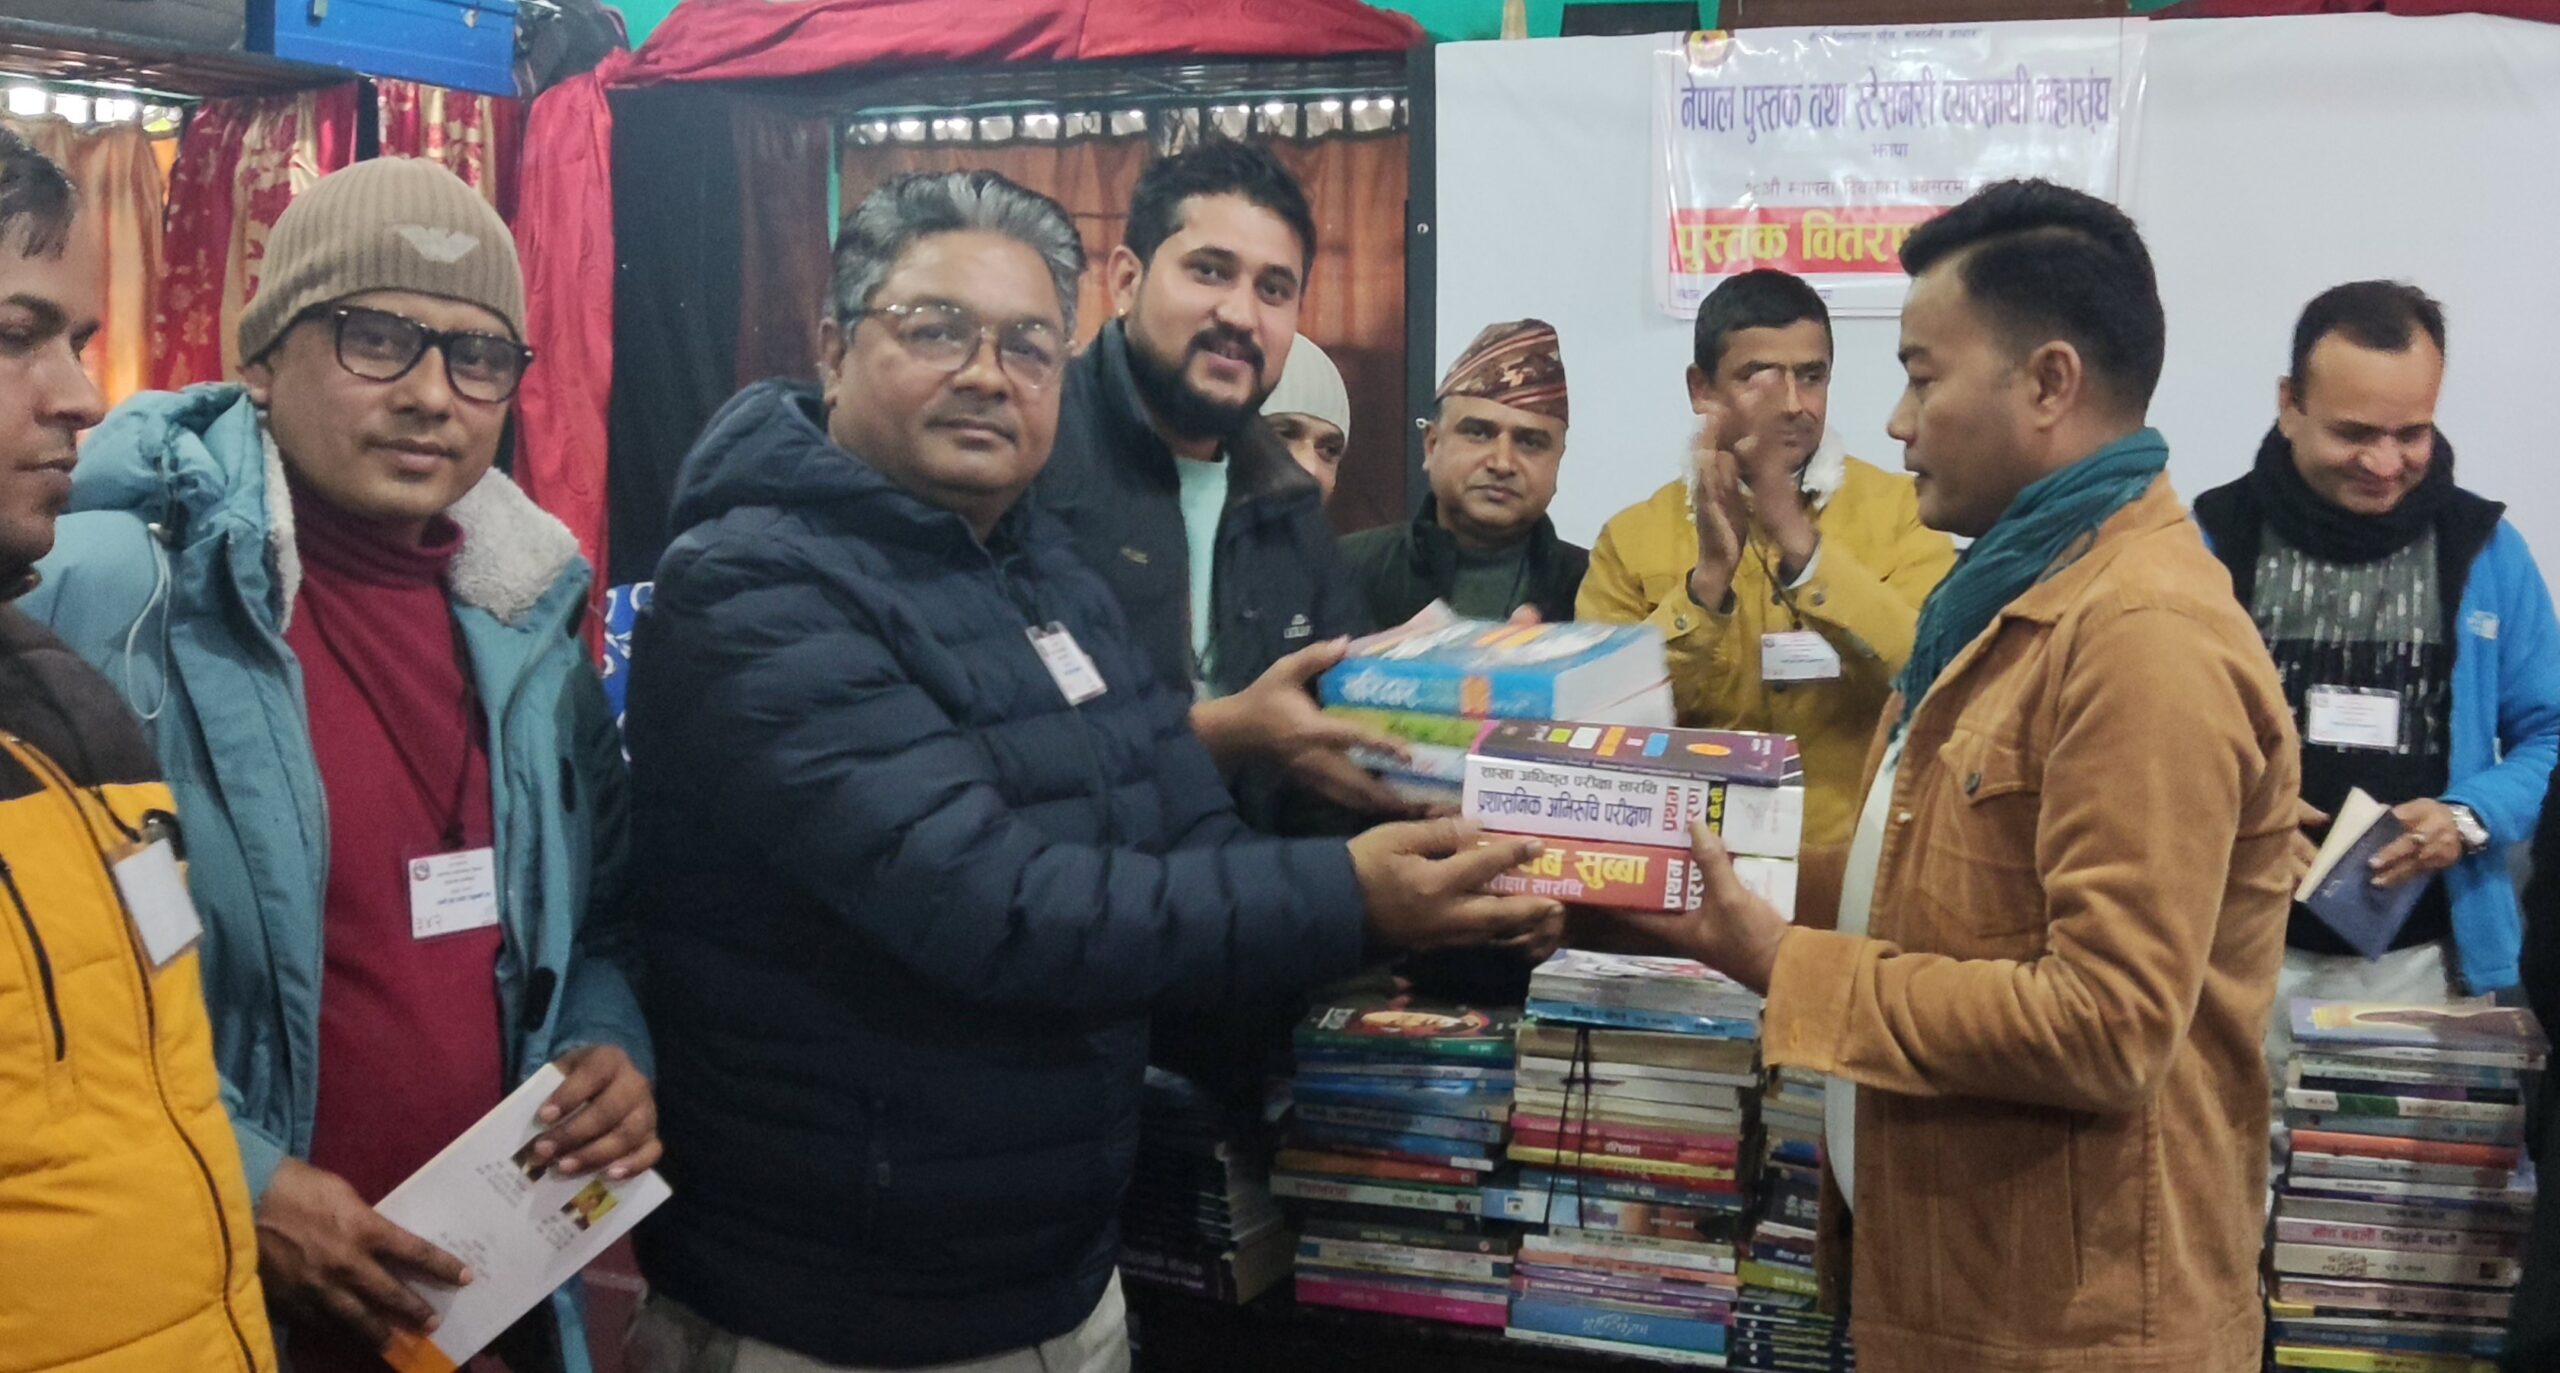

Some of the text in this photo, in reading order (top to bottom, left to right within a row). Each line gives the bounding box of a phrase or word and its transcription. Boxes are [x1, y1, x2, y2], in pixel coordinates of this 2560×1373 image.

[1681, 71, 1736, 132] नेपाल
[1743, 84, 1802, 144] पुस्तक
[1810, 83, 1847, 129] तथा
[1679, 223, 1790, 273] पुस्तक
[1481, 766, 1514, 781] शाखा
[1519, 767, 1569, 787] अधिकृत
[1478, 786, 1542, 816] प्रशासनिक
[1605, 797, 1652, 828] परीक्षण
[1574, 850, 1649, 890] सुब्बा
